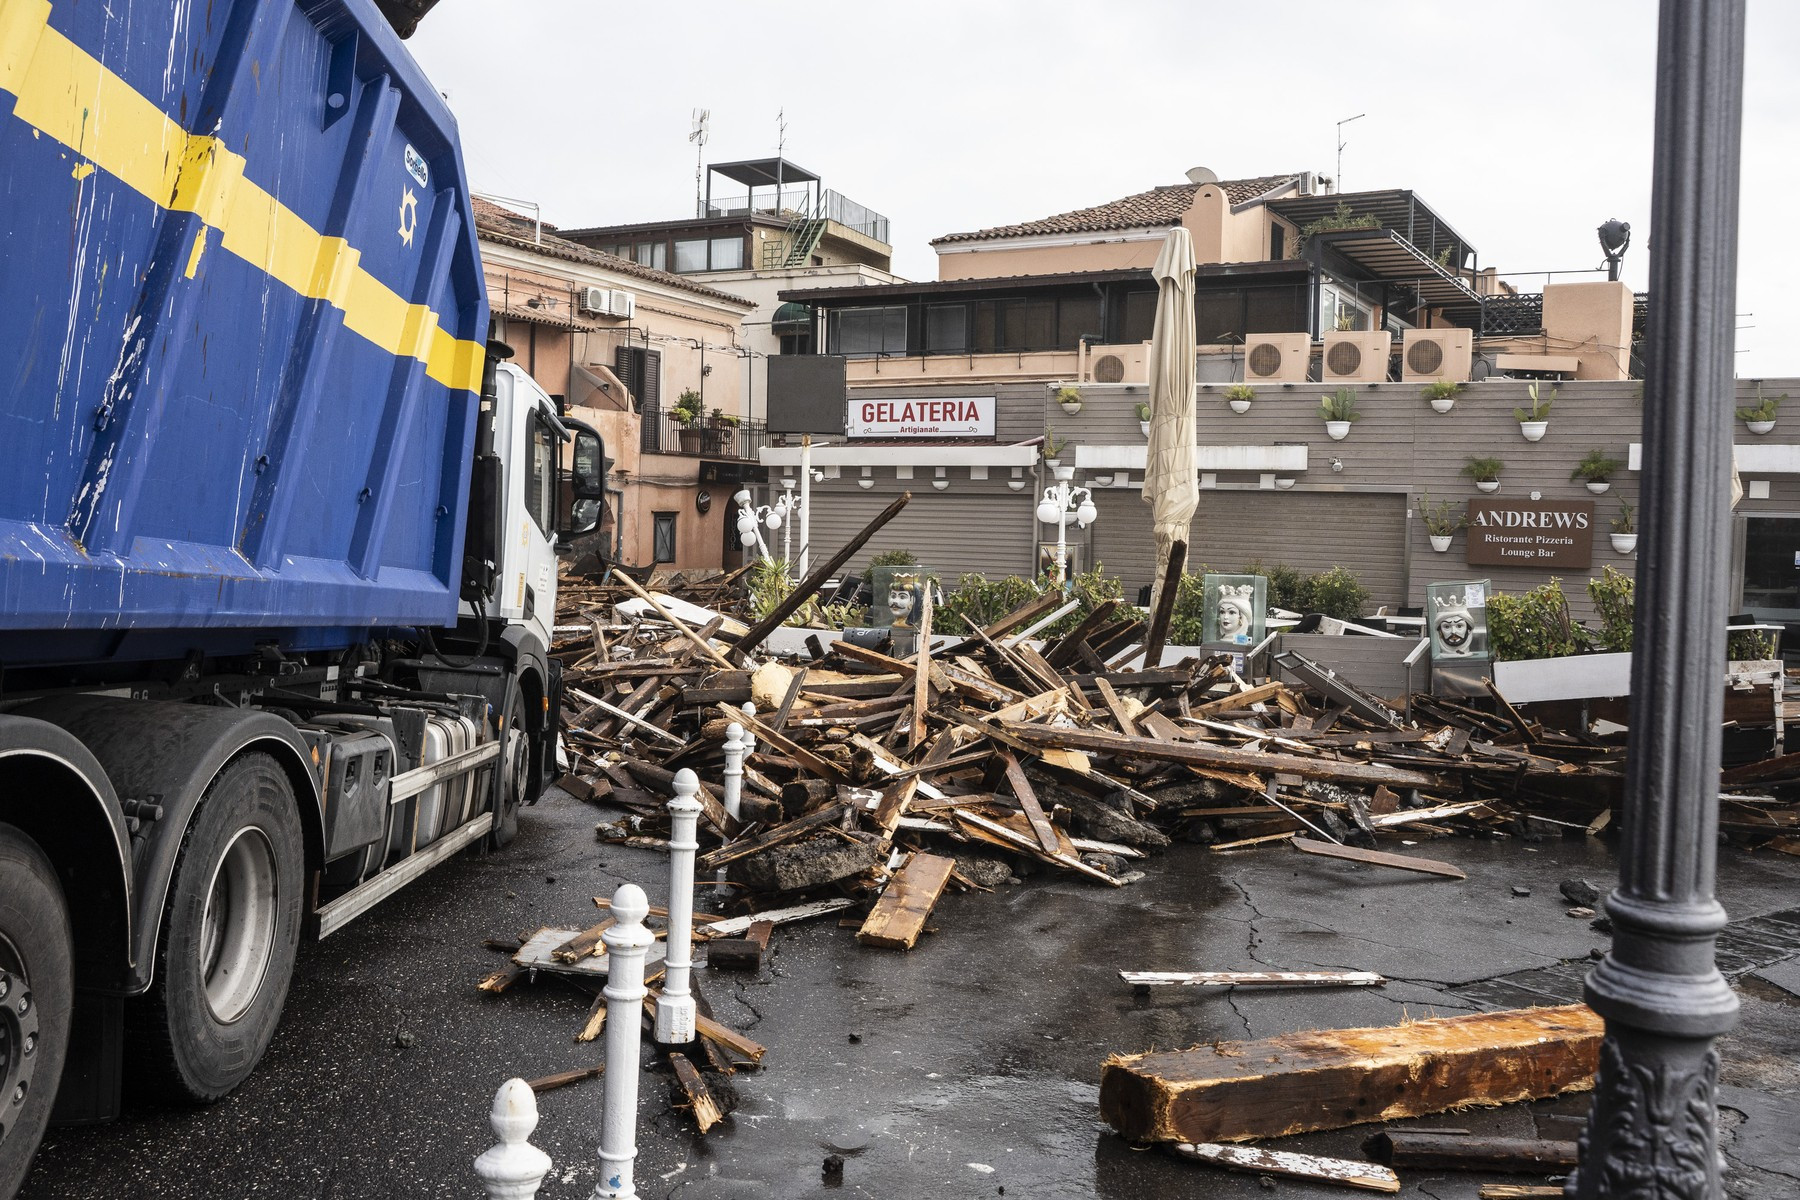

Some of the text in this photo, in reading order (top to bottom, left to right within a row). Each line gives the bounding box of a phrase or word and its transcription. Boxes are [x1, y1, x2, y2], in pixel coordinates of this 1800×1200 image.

[405, 150, 427, 183] Sorbello
[861, 401, 980, 423] GELATERIA
[900, 426, 940, 434] Artigianale
[1474, 510, 1588, 529] ANDREWS
[1484, 534, 1574, 545] Ristorante Pizzeria
[1501, 548, 1556, 558] Lounge Bar
